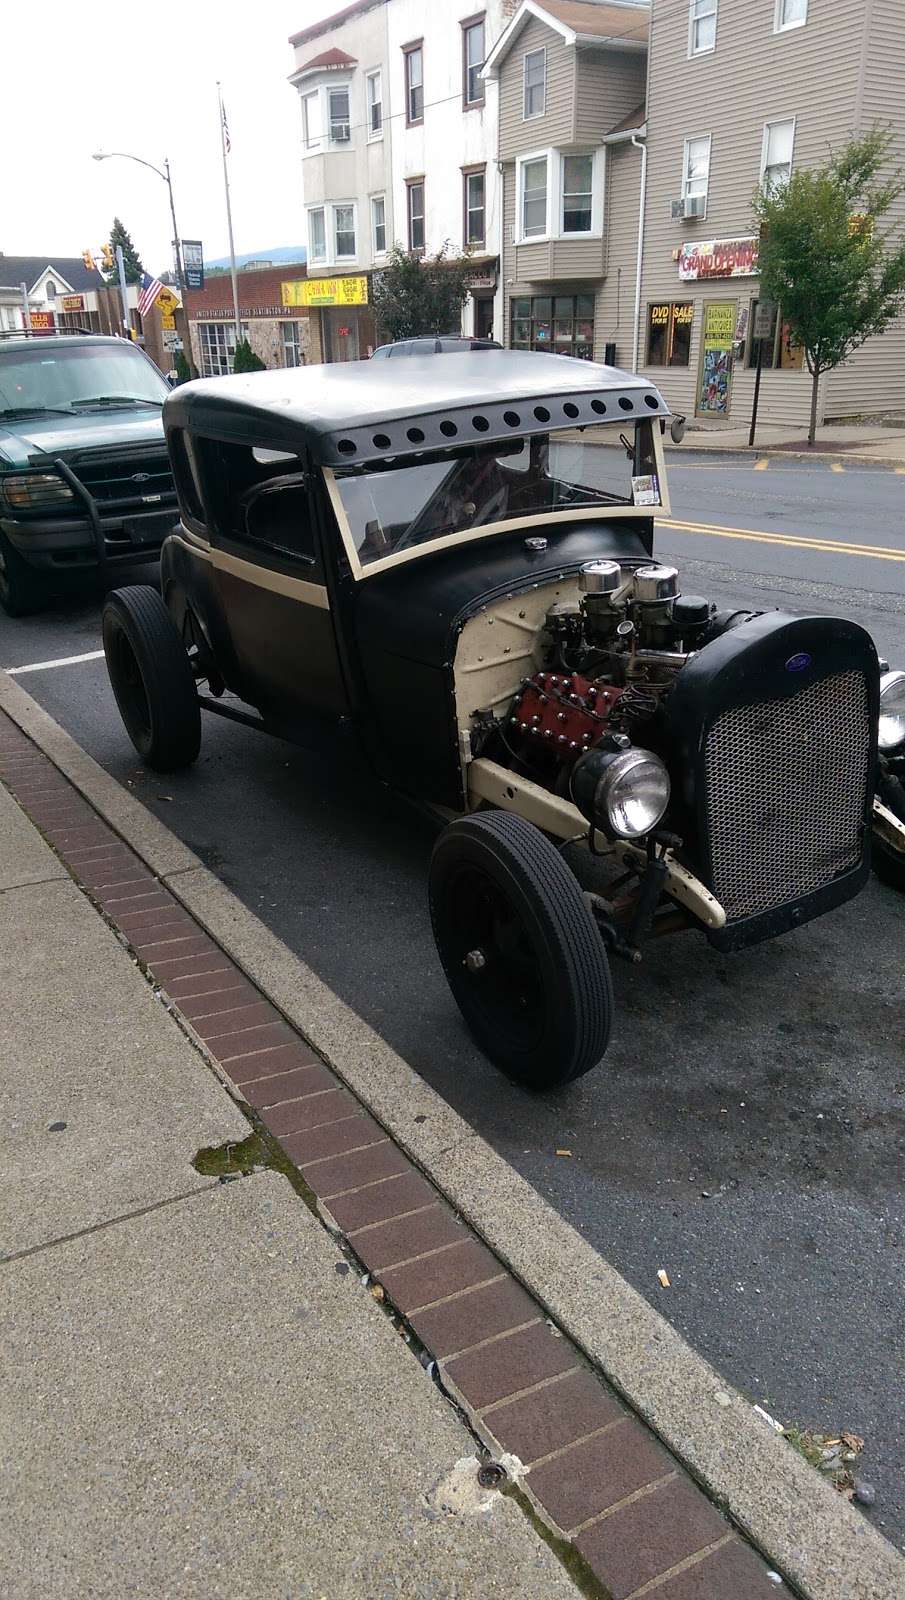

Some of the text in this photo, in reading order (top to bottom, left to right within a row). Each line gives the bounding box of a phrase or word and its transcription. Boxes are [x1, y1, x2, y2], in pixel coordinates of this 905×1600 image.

[682, 254, 713, 271] GRAND
[31, 314, 48, 322] ELLS
[652, 305, 693, 318] DVD SALE
